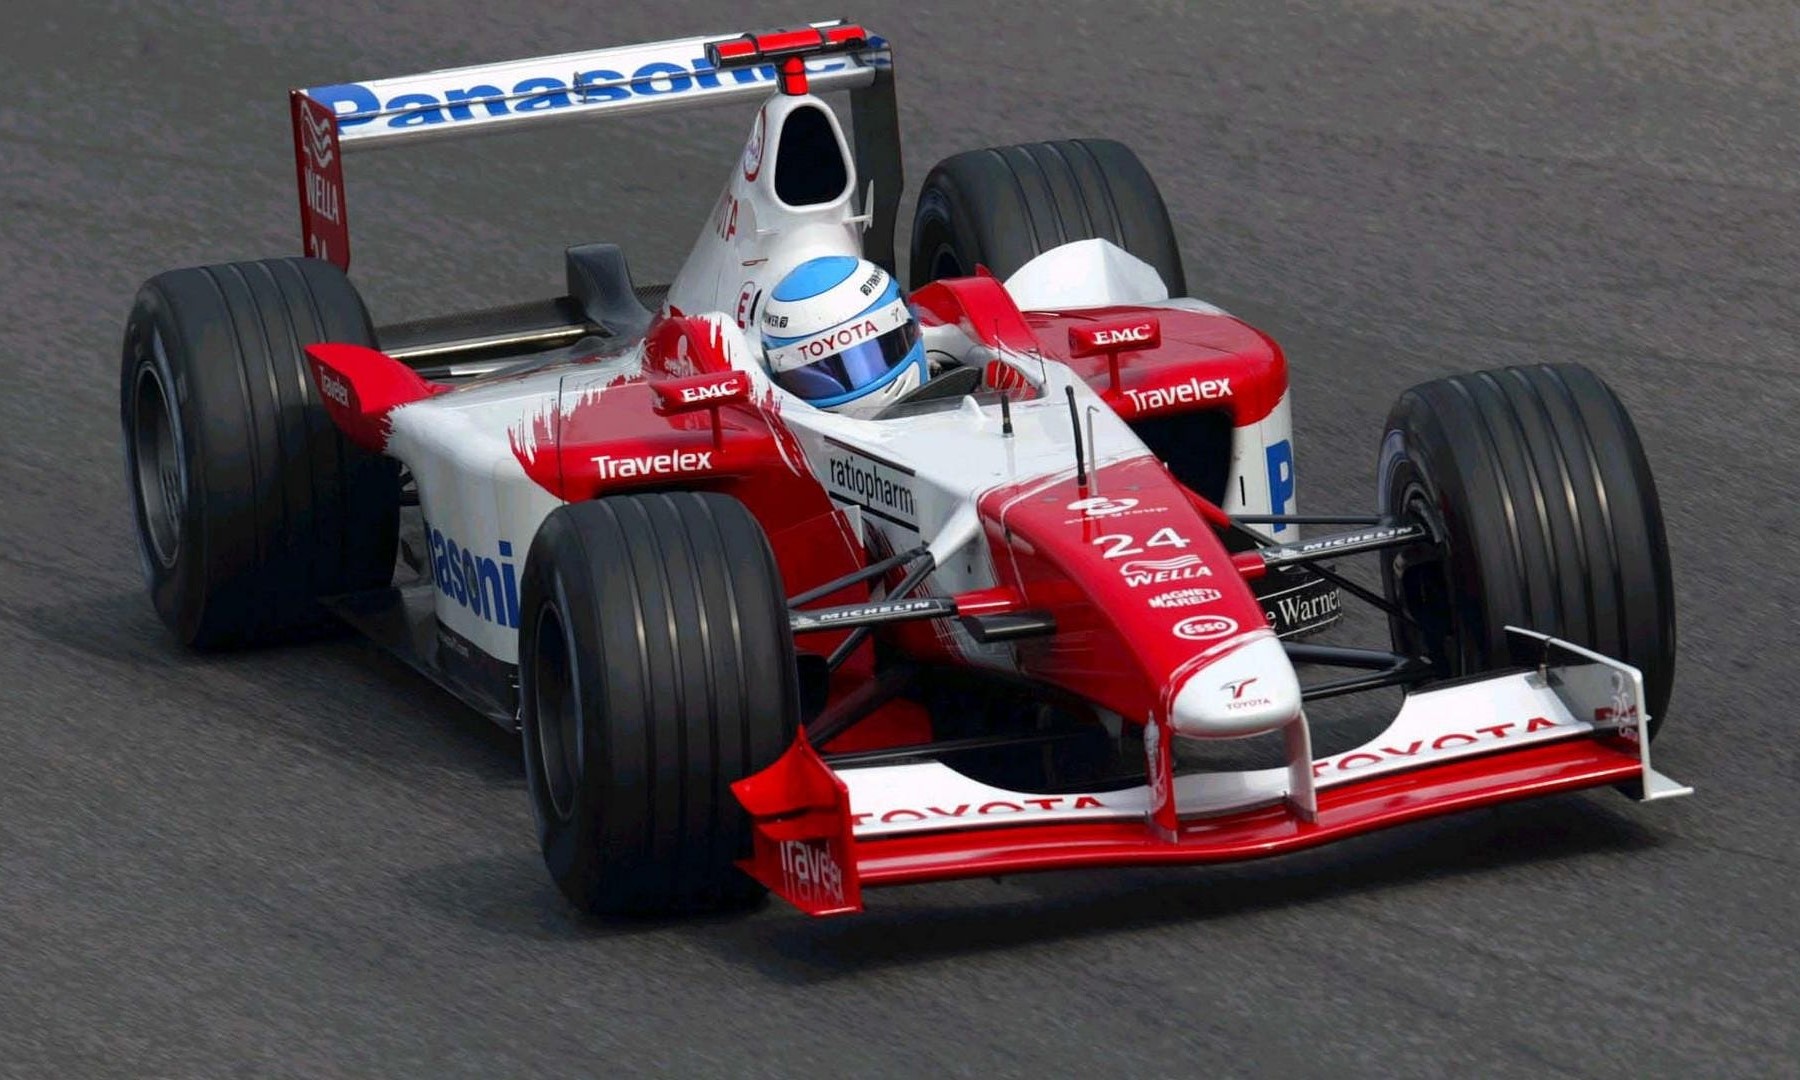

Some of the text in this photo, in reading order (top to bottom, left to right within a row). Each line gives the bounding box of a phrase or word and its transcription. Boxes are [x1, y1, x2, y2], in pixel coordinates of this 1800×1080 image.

[305, 166, 339, 225] WELLA
[798, 319, 879, 361] TOYOTA
[1124, 377, 1233, 412] Travelex
[590, 449, 713, 480] Travelex
[829, 456, 915, 516] ratiopharm
[1092, 527, 1191, 560] 24
[1303, 526, 1412, 553] MICHELIN
[1124, 565, 1213, 588] WELLA
[819, 600, 931, 621] MICHELIN
[1181, 621, 1228, 635] Esso
[1225, 698, 1272, 711] TOYOTA
